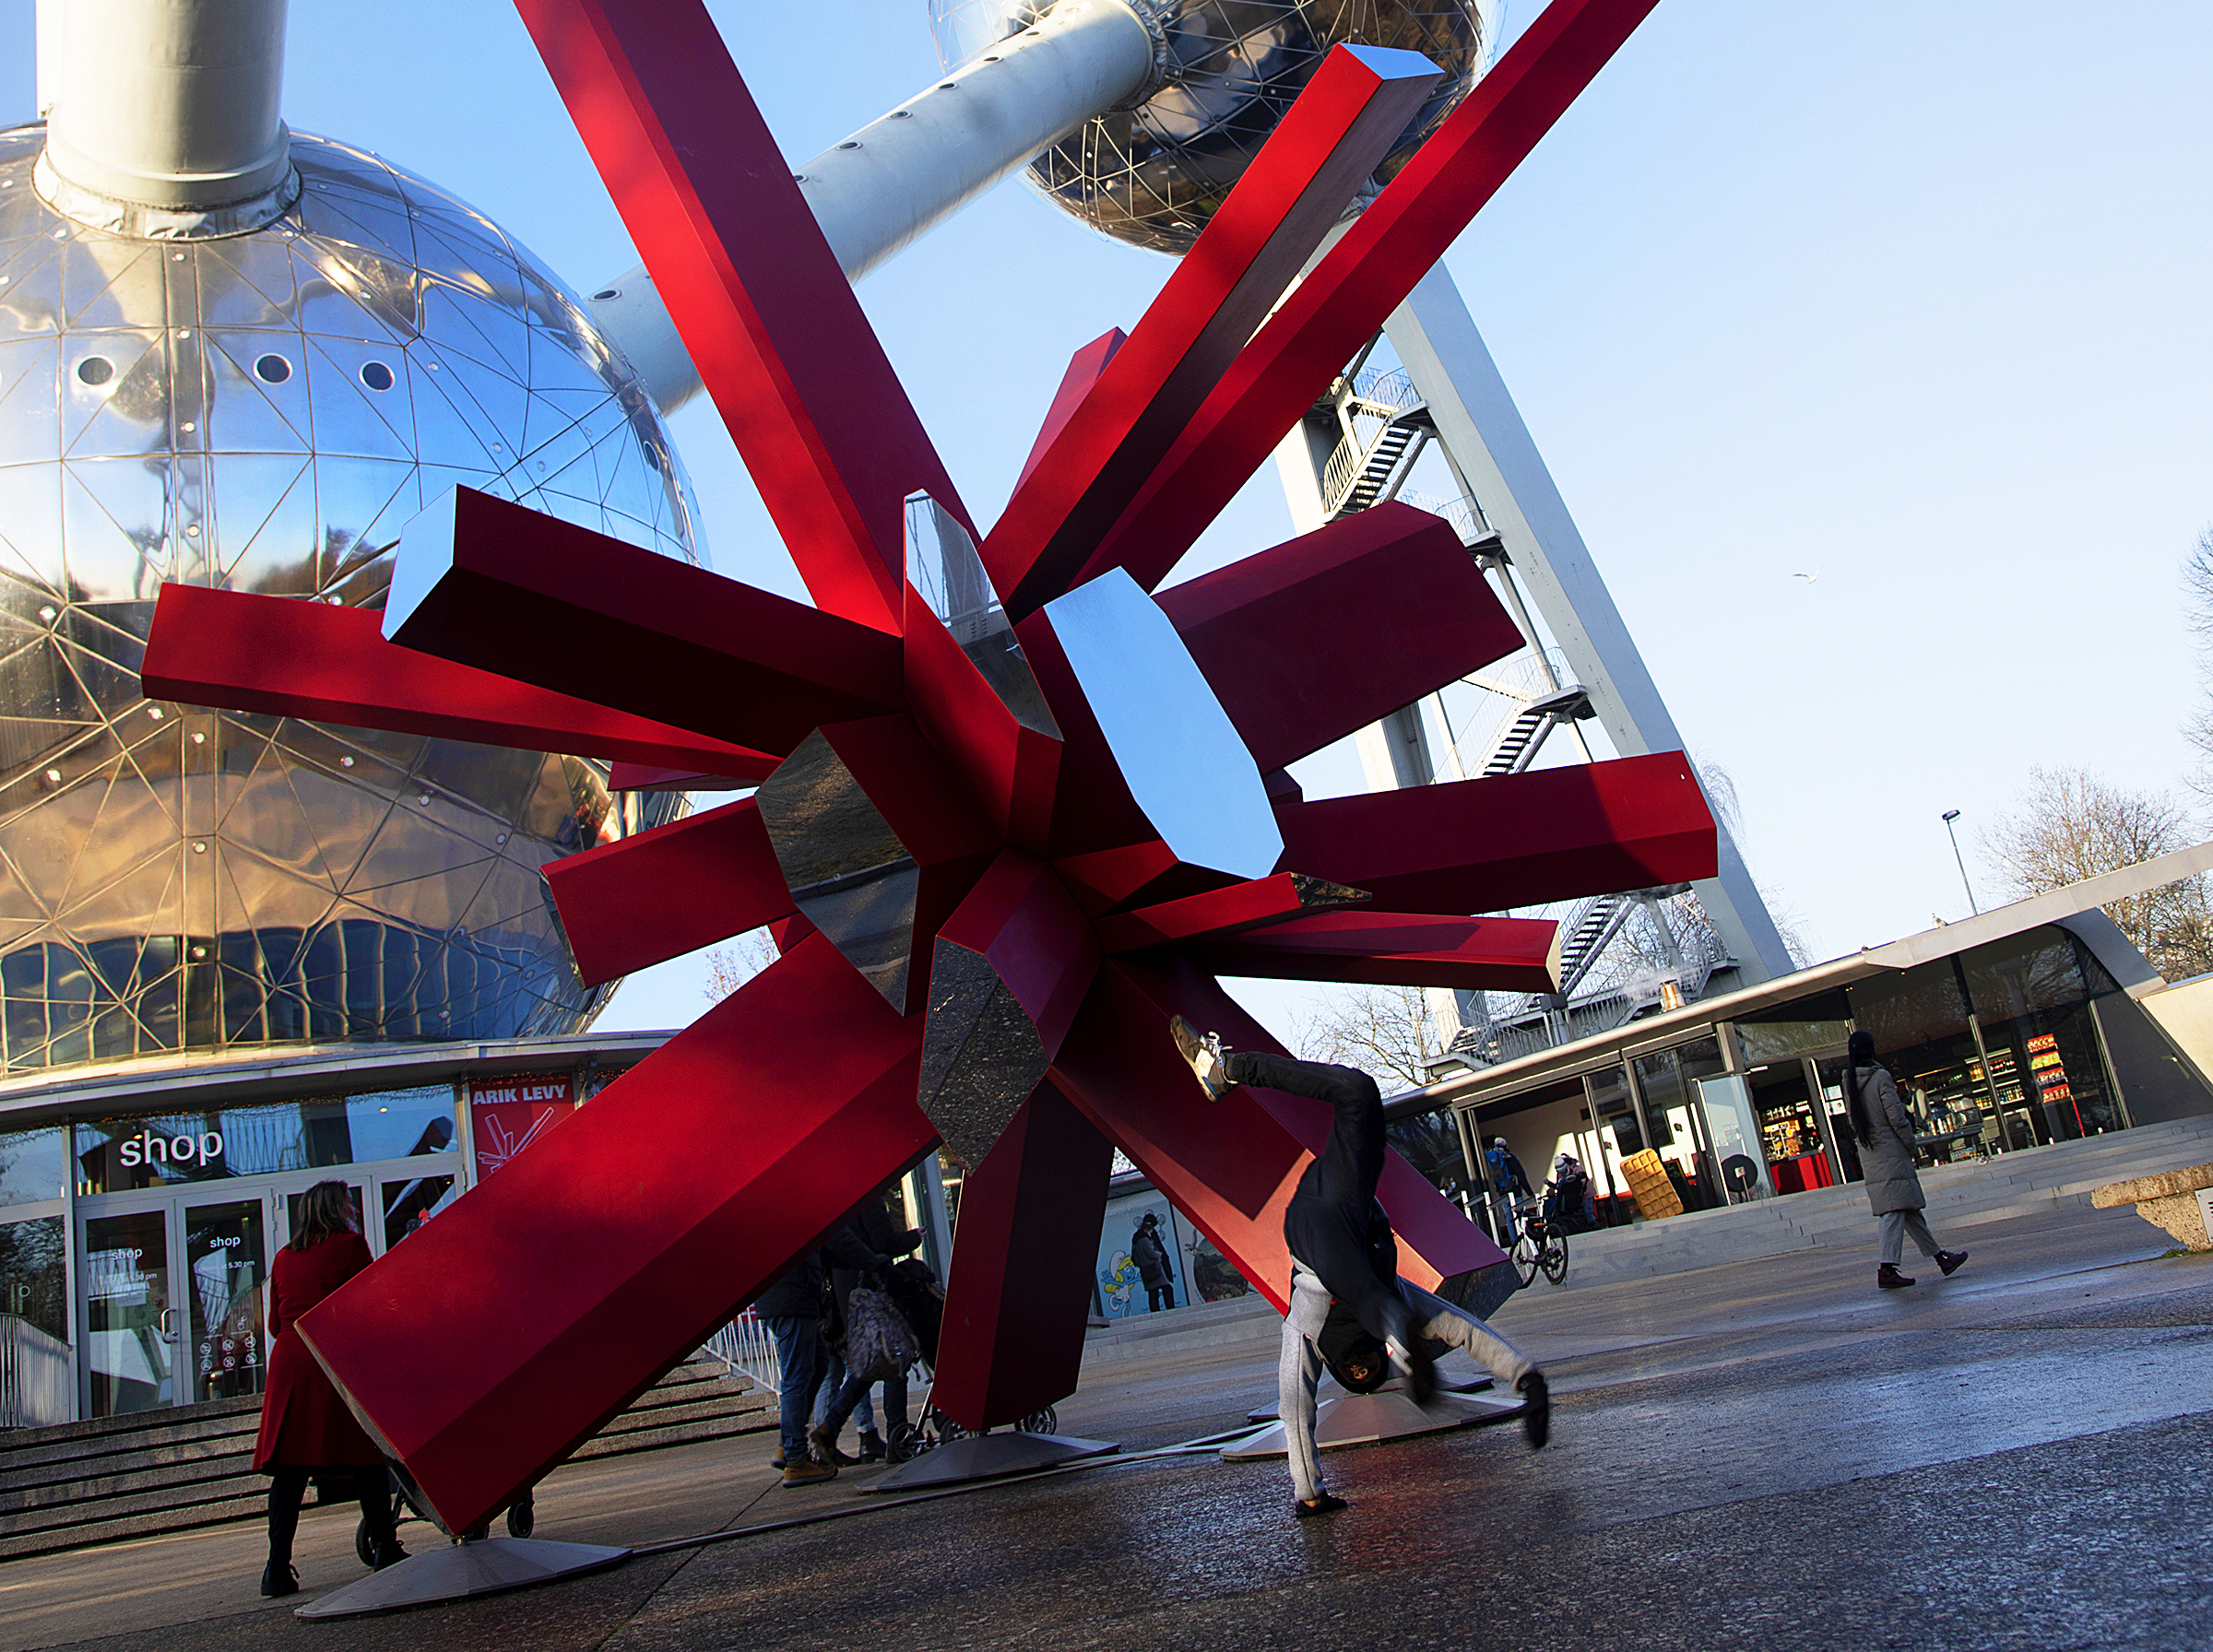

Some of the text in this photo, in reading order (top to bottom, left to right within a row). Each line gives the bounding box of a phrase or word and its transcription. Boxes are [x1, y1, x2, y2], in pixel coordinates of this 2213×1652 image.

[472, 1084, 566, 1105] ARIK LEVY
[120, 1129, 223, 1167] shop
[209, 1236, 241, 1248] shop
[112, 1248, 143, 1260] shop
[228, 1260, 243, 1269] 5.30
[243, 1260, 255, 1268] pm
